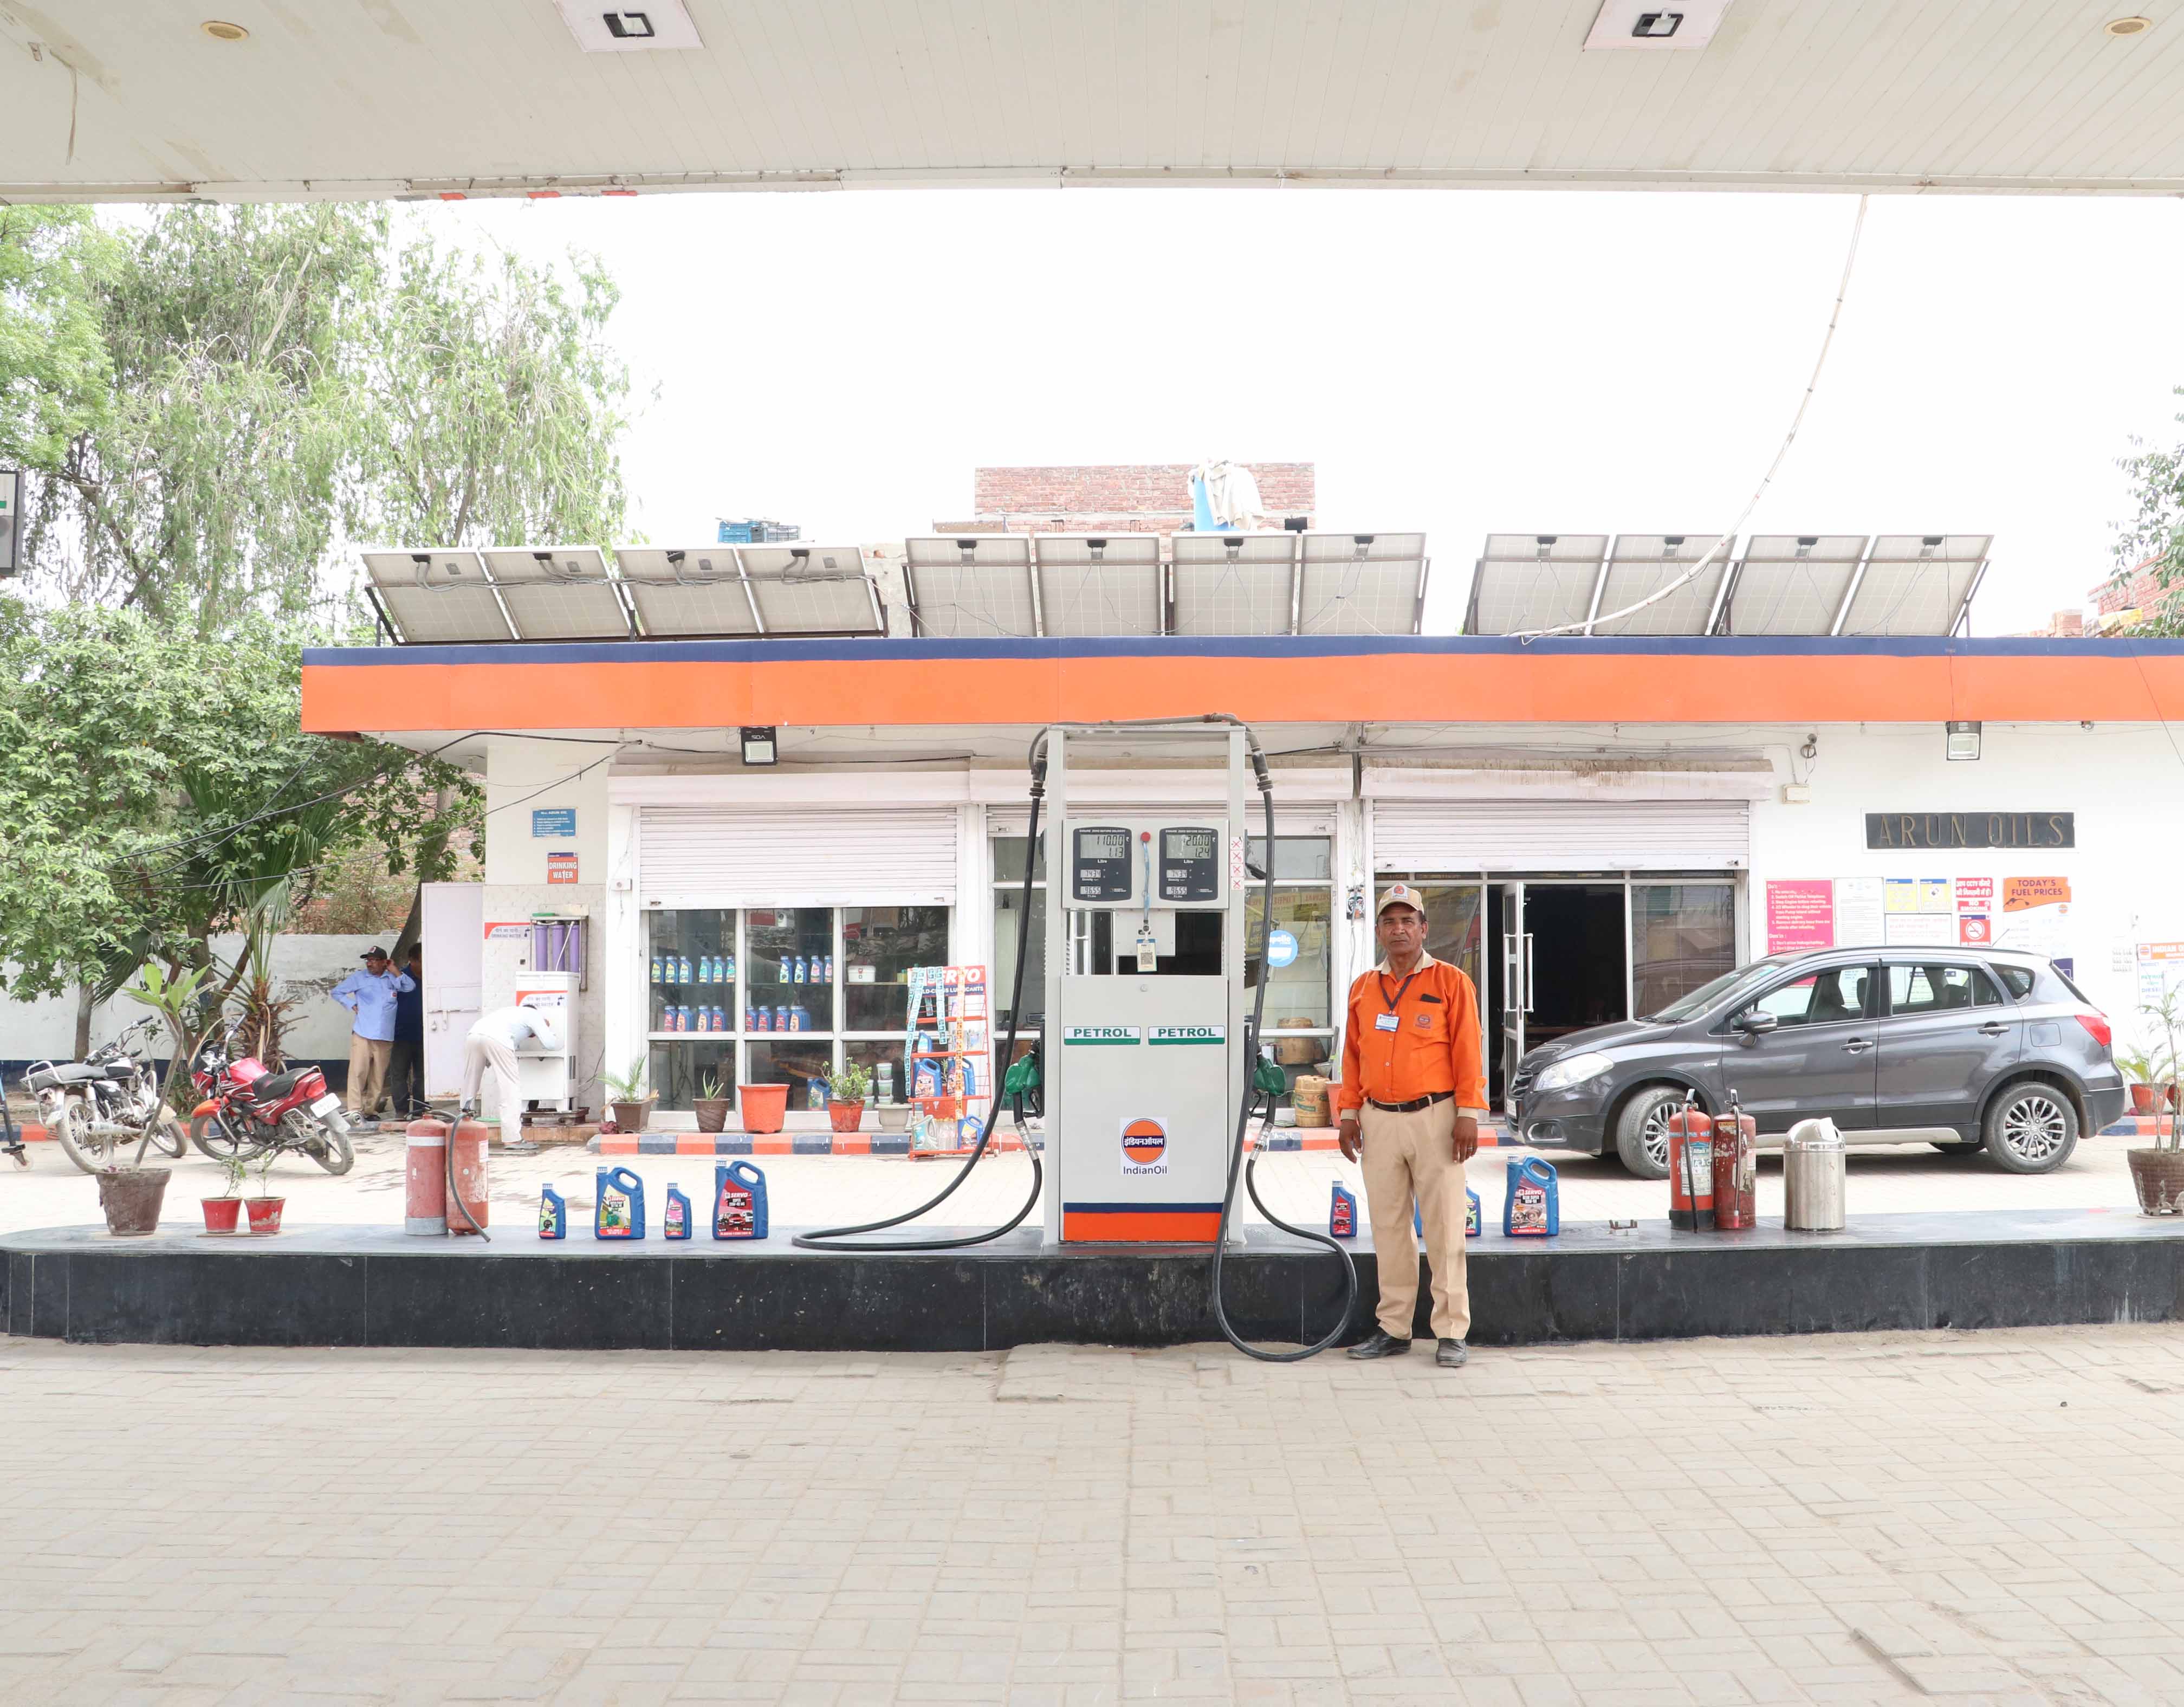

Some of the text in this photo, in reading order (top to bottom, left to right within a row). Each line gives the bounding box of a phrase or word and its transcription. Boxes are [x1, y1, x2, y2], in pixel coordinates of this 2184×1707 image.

[1878, 814, 2065, 846] ARUN OILS
[1074, 1029, 1131, 1037] PETROL
[1158, 1028, 1216, 1037] PETROL
[1124, 1137, 1164, 1147] इंडियनऑयल
